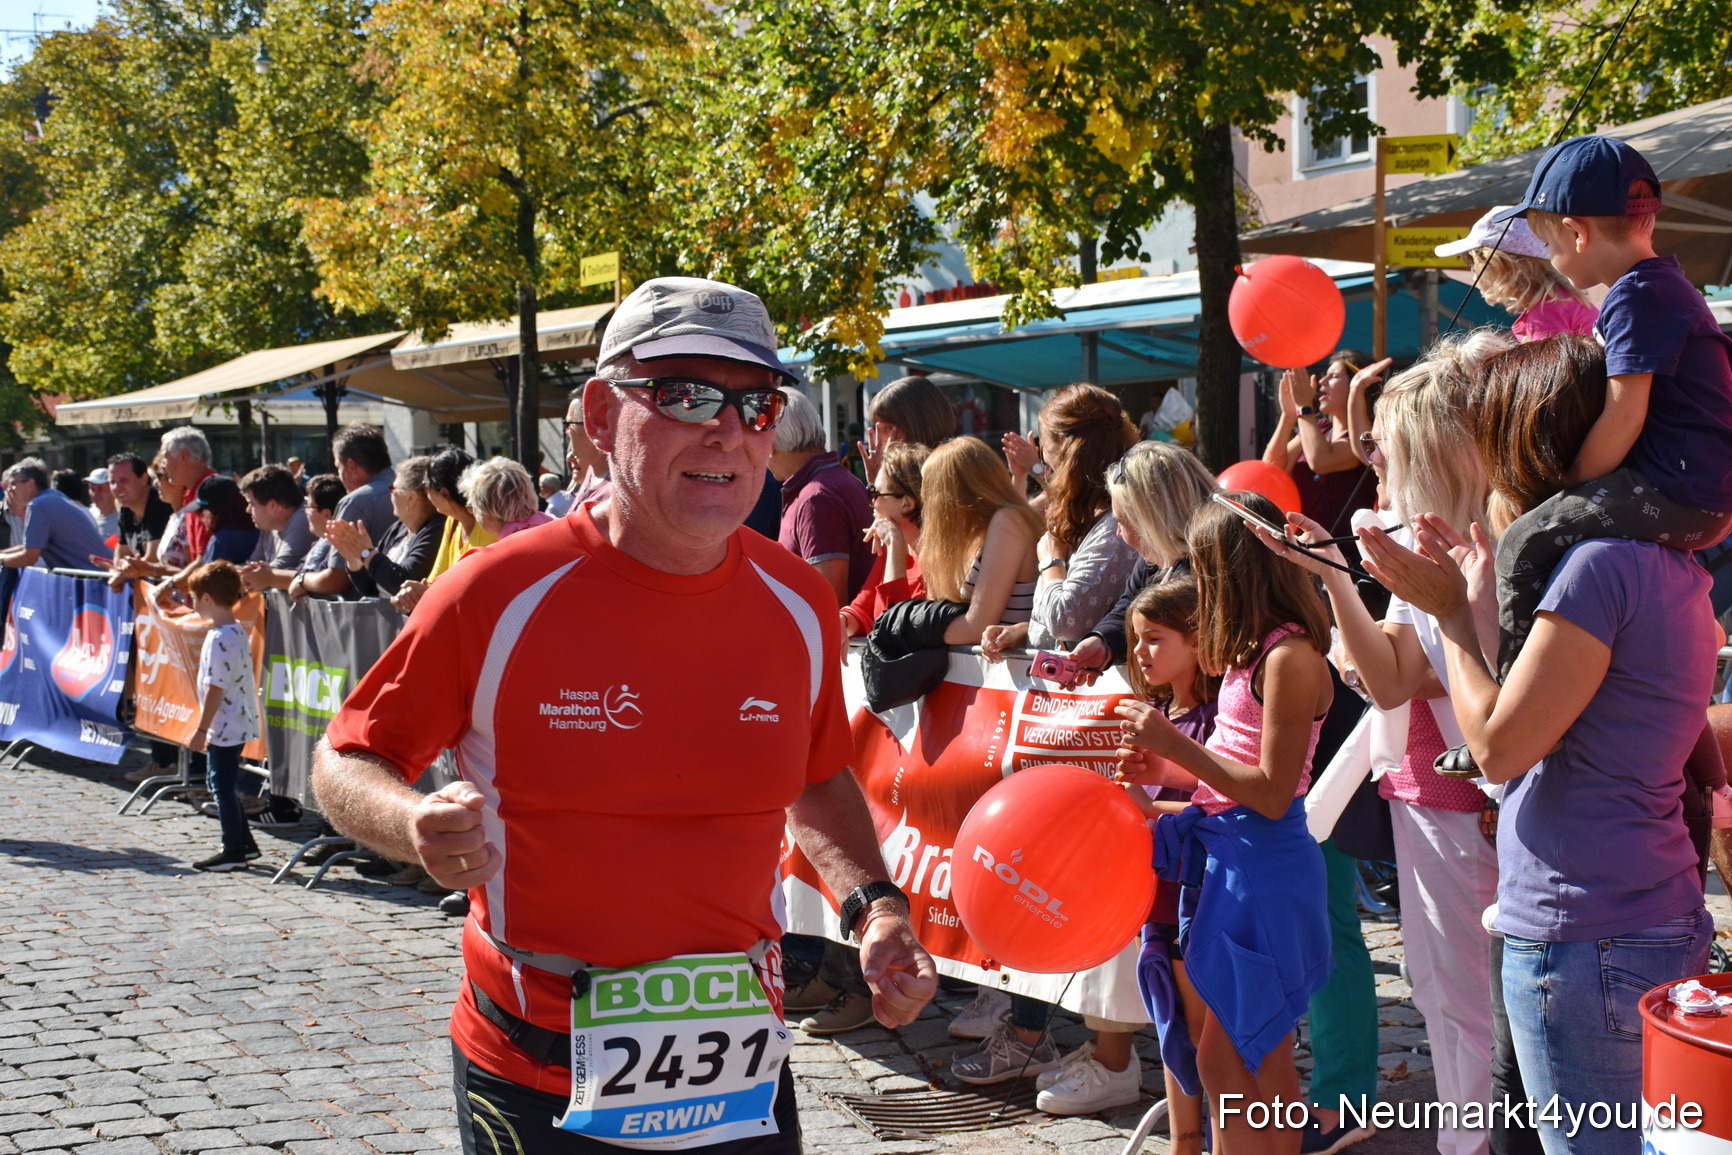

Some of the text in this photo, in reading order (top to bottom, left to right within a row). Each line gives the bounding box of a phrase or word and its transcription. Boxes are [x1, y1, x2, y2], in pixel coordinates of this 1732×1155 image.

[1395, 157, 1430, 171] ausgabe
[588, 263, 616, 276] Toiletten
[700, 292, 732, 311] Buff
[560, 689, 599, 702] Haspa
[1031, 696, 1106, 717] BINDESTRICKE
[153, 696, 194, 723] Agentur
[539, 703, 601, 716] Marathon
[740, 713, 779, 722] LI-NING
[549, 718, 607, 732] Hamburg
[984, 711, 1007, 768] Seit 1929
[893, 766, 905, 789] 1929
[881, 807, 953, 900] Bra
[928, 906, 961, 928] Sicher
[1013, 893, 1063, 928] energie
[594, 967, 768, 1014] BOCK
[600, 1028, 769, 1097] 2431
[620, 1101, 726, 1134] ERWIN
